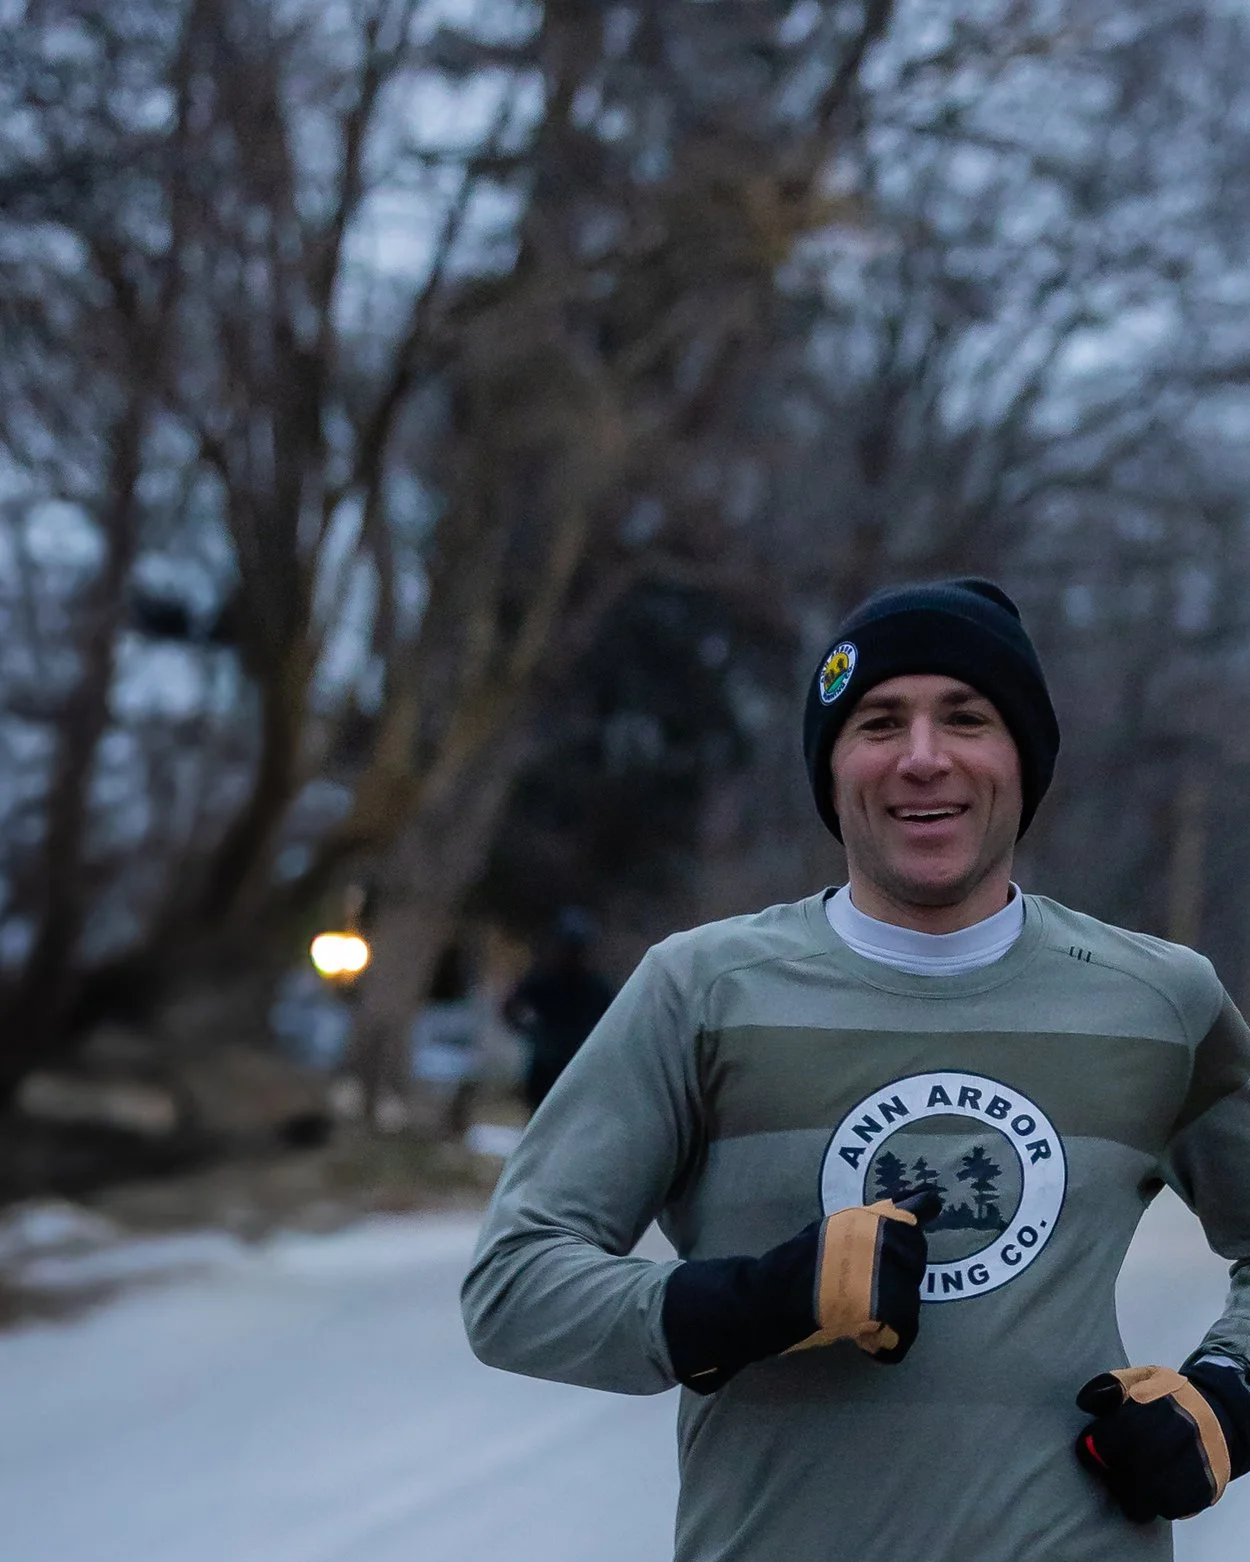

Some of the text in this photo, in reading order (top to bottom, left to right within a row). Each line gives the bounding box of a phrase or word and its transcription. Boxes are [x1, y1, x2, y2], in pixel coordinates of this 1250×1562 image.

[838, 1085, 1052, 1170] ANN ARBOR
[1000, 1219, 1047, 1266] CO.
